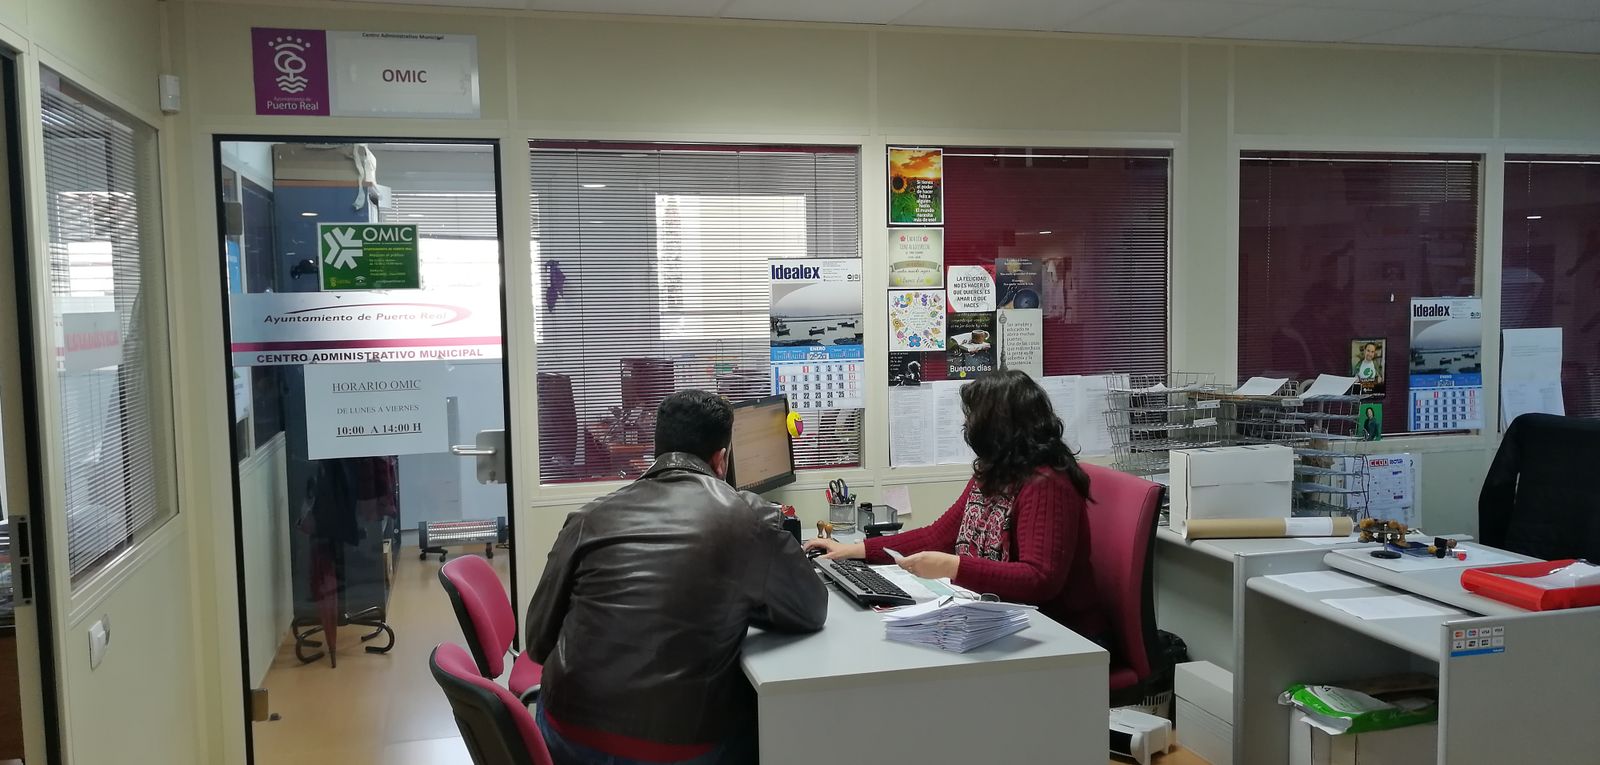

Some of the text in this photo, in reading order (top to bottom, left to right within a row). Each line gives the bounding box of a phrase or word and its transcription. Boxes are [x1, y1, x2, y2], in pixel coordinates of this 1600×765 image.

[382, 69, 427, 83] OMIC
[267, 101, 318, 110] Puerto Real
[362, 227, 412, 241] OMIC
[771, 265, 820, 280] Idealex
[1413, 304, 1450, 317] Idealex
[264, 311, 447, 325] Ayuntamiento de Puerto Real
[257, 349, 484, 363] CENTRO ADMINISTRATIVO MUNICIPAL
[332, 379, 422, 391] HORARIO OMIC
[336, 422, 422, 436] 10:00 A 14:00 H
